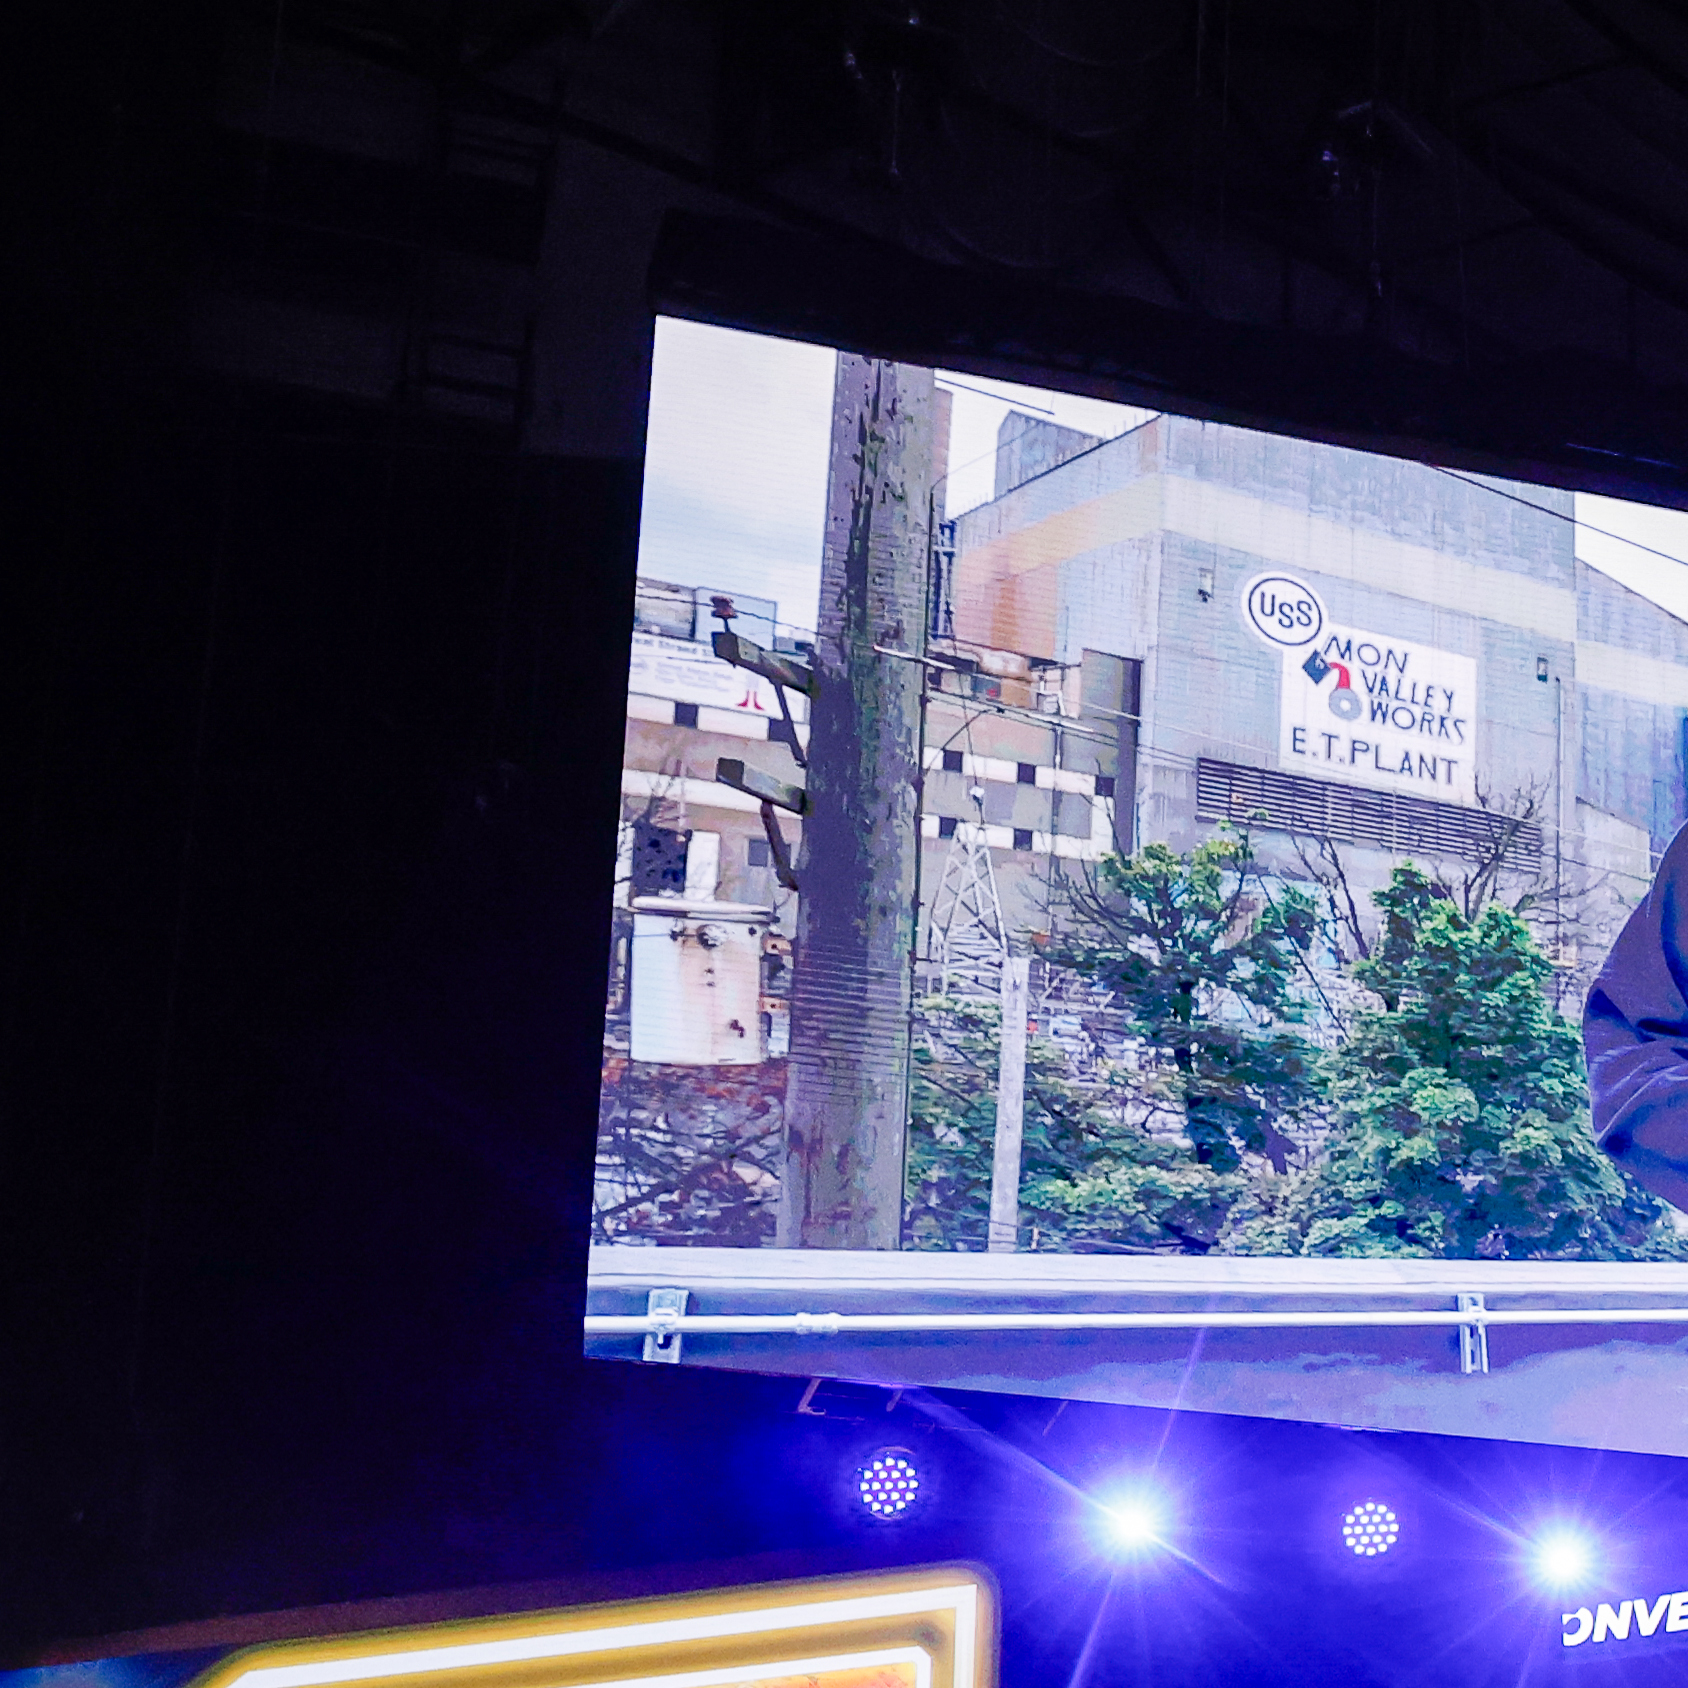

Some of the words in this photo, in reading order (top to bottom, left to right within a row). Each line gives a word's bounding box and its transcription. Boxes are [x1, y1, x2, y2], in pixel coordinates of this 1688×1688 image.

[1259, 591, 1313, 628] USS
[1323, 636, 1408, 674] MON
[1361, 669, 1453, 713] VALLEY
[1370, 699, 1466, 746] WORKS
